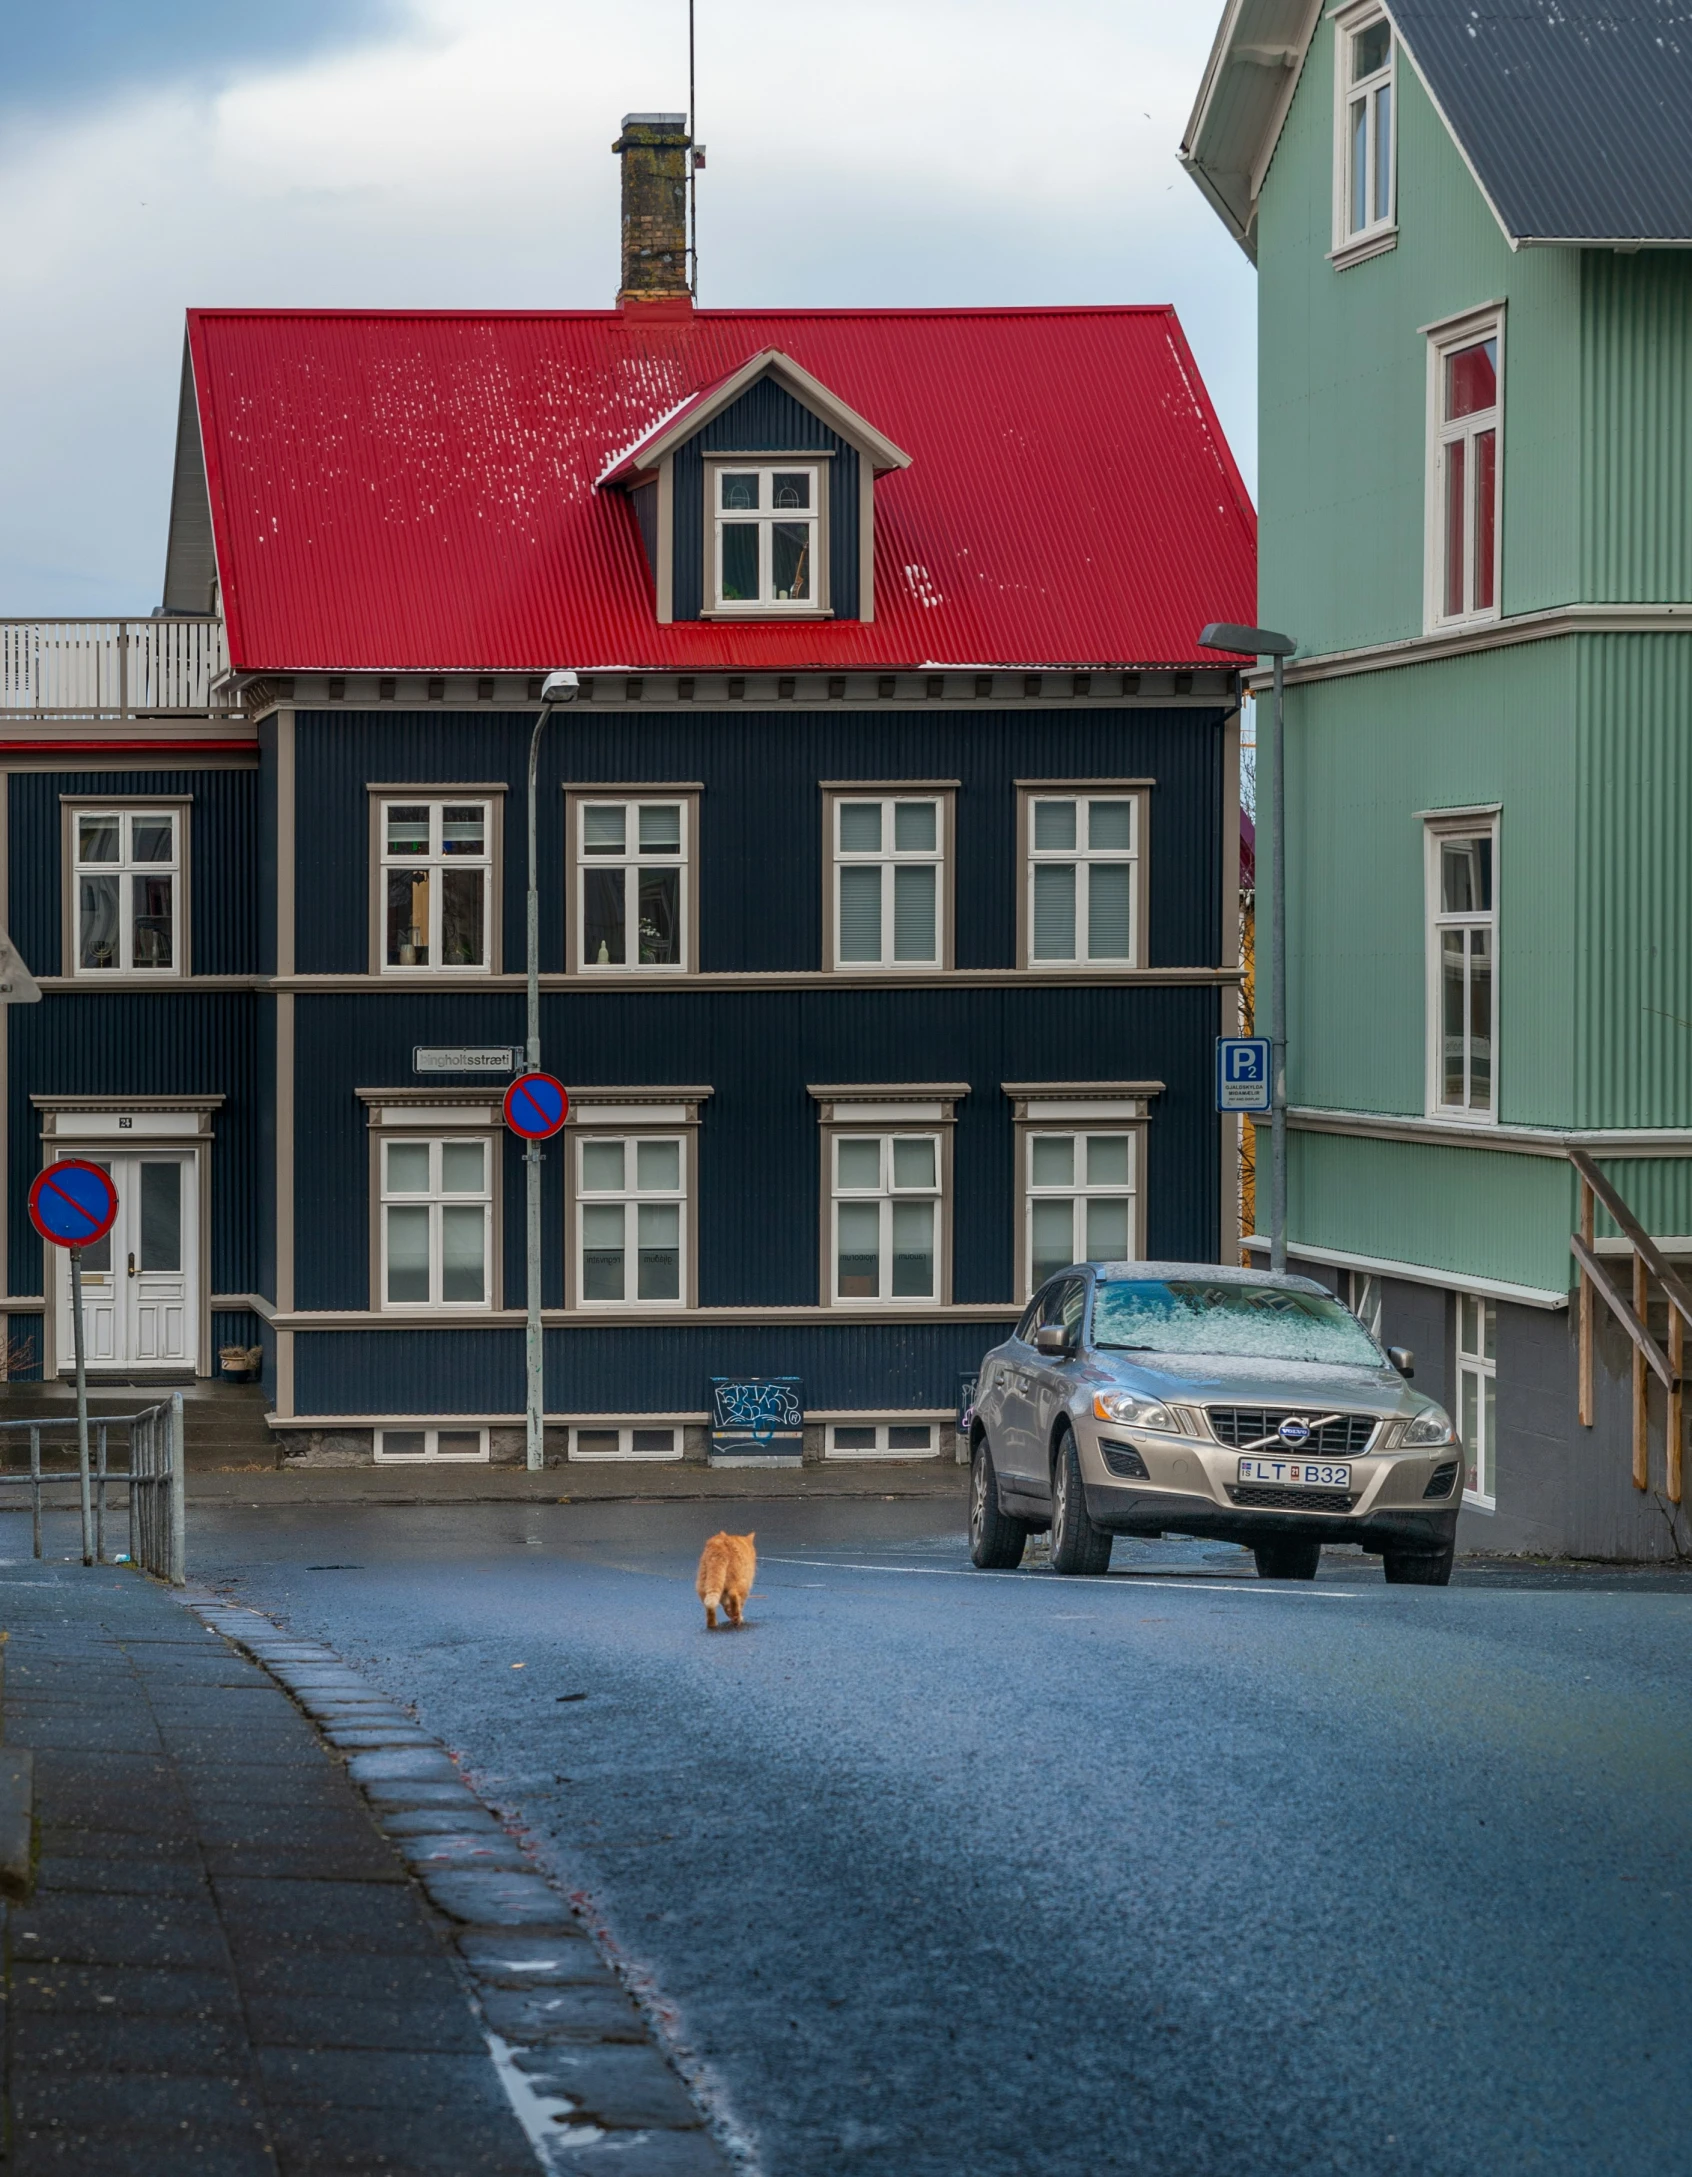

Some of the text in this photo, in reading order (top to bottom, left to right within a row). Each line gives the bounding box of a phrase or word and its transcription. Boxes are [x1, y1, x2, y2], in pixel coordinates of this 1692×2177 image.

[120, 1118, 131, 1128] 24
[1256, 1462, 1347, 1485] LT B32
[1291, 1467, 1299, 1476] 21
